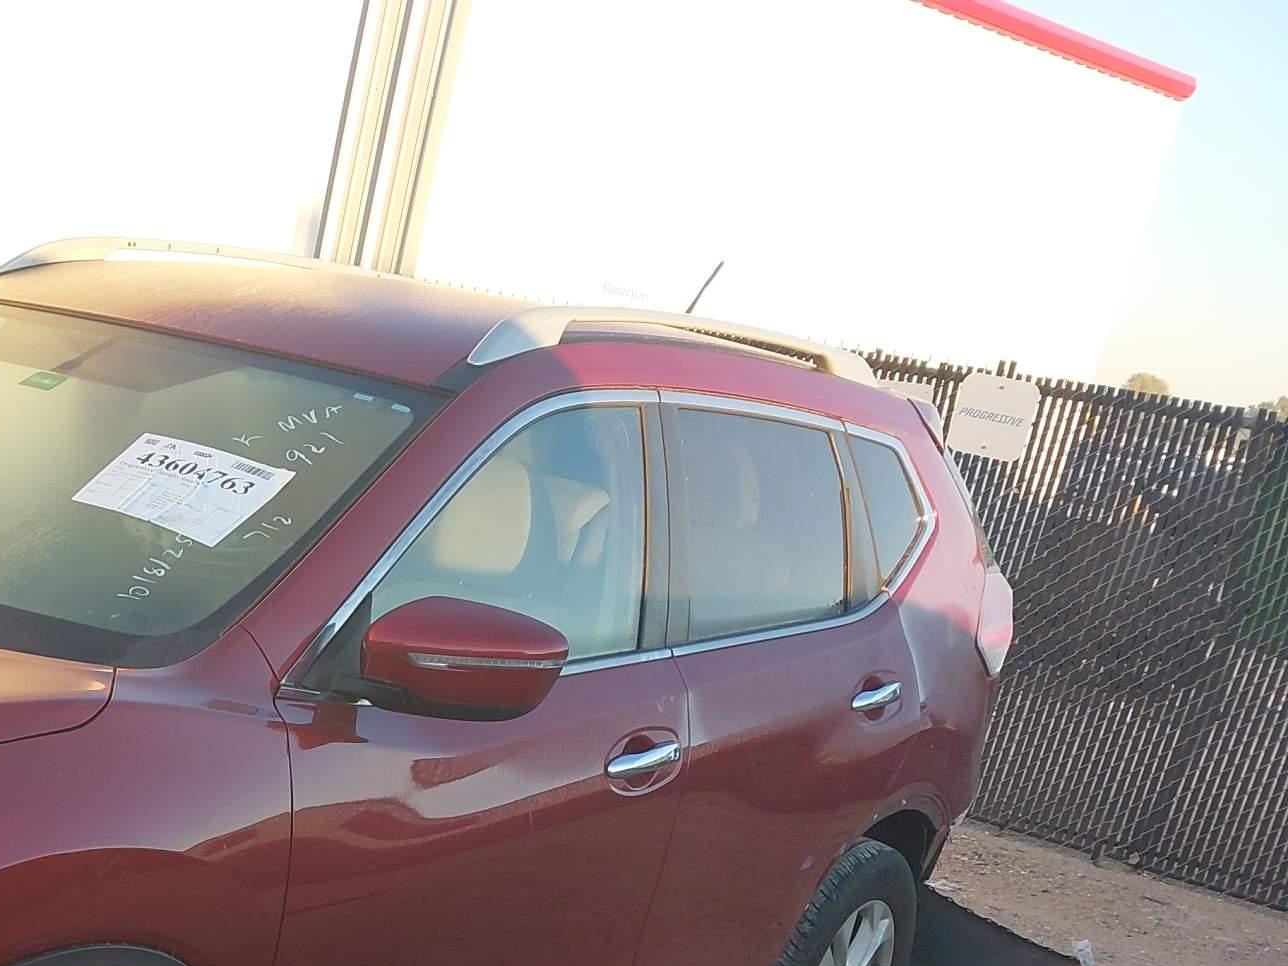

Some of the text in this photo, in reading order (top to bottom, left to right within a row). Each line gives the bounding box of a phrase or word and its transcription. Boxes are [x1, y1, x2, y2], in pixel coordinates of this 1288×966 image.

[278, 405, 342, 432] MVA
[959, 406, 1025, 428] PROGRESSIVE
[136, 452, 256, 495] 43604763
